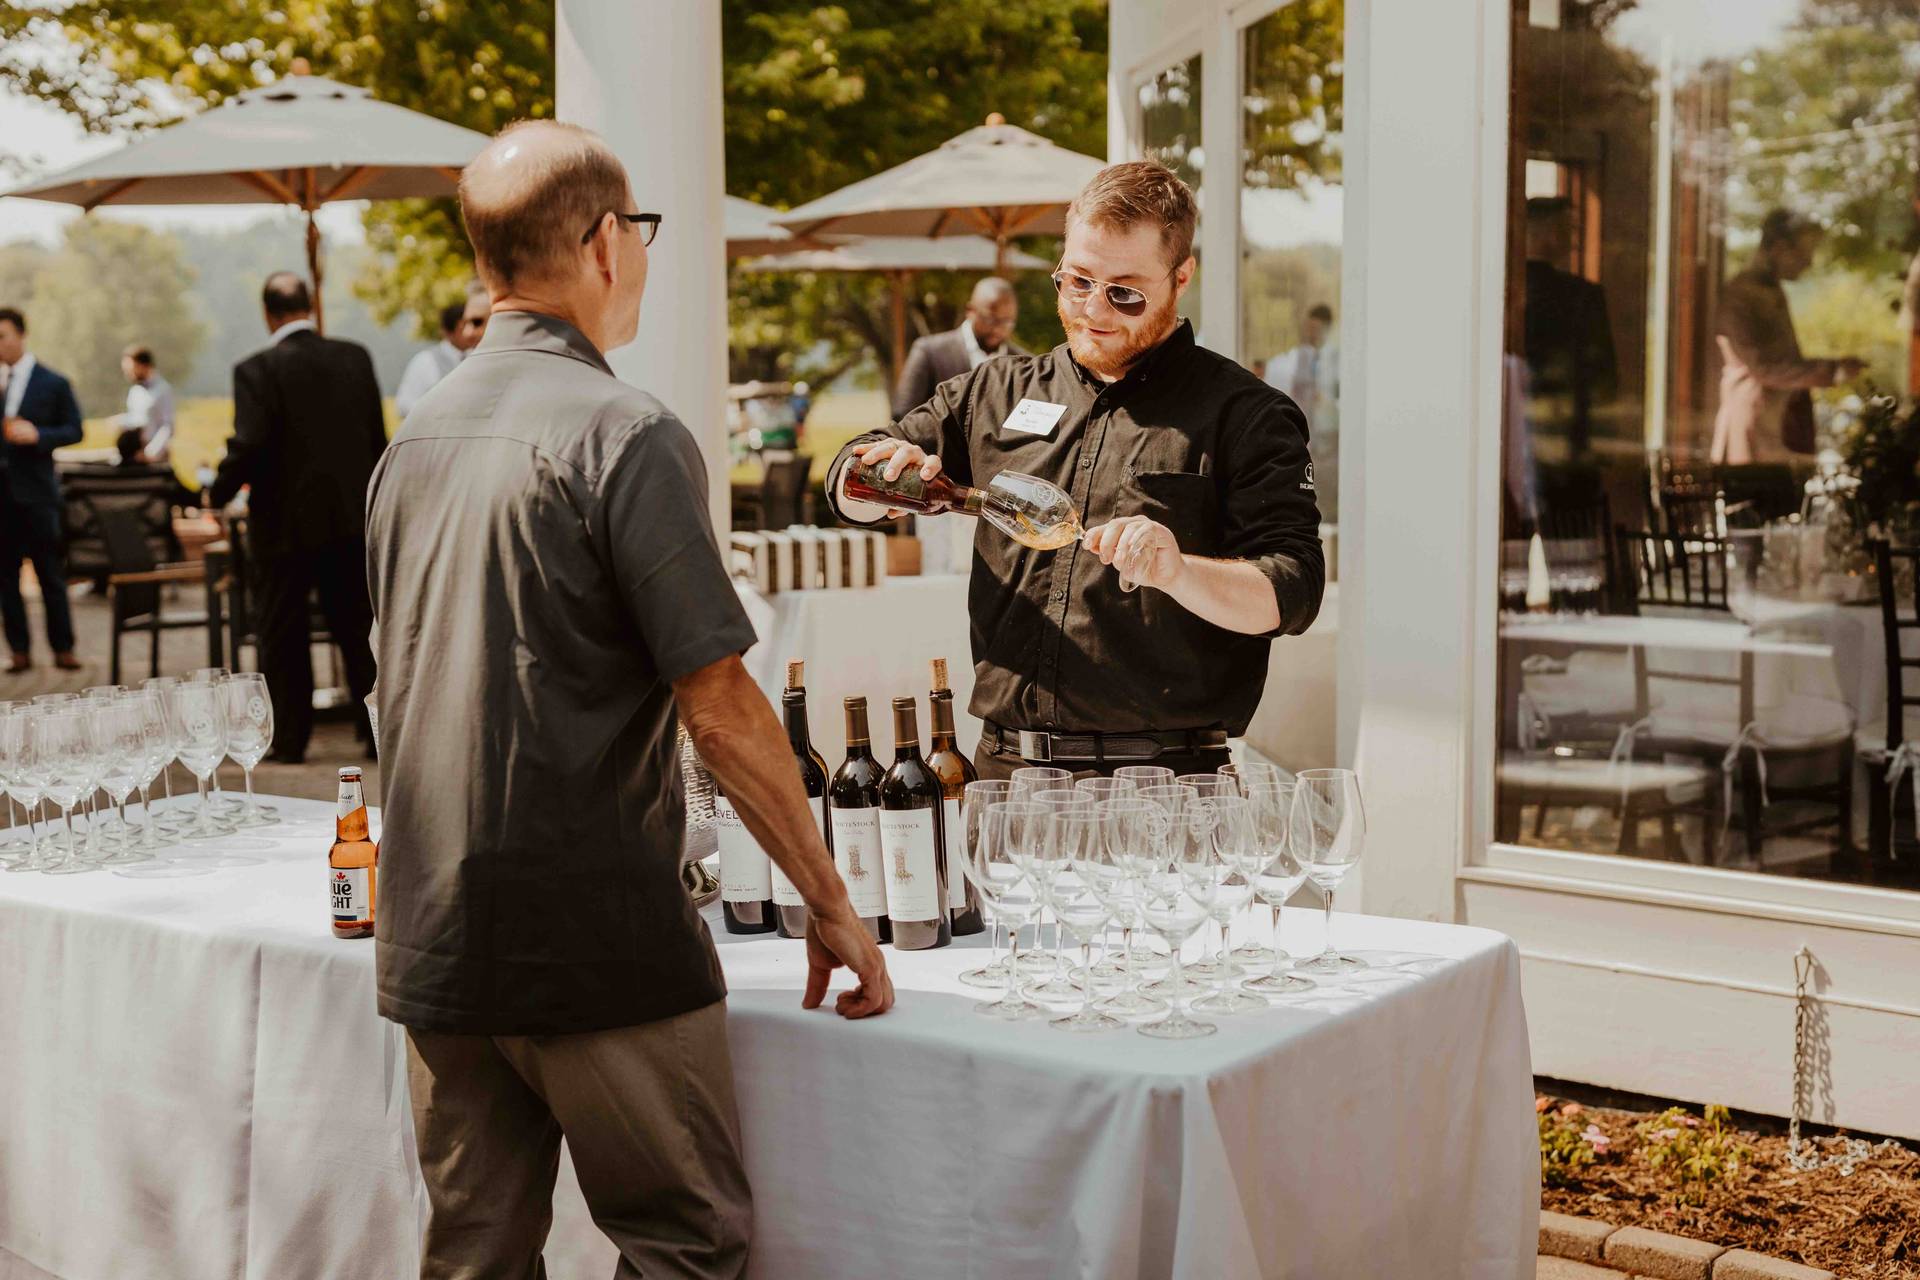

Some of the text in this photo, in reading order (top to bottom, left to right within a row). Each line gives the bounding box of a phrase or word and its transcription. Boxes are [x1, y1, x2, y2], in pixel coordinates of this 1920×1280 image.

[715, 810, 739, 820] EVEL
[332, 883, 352, 896] ue
[332, 896, 352, 909] GHT
